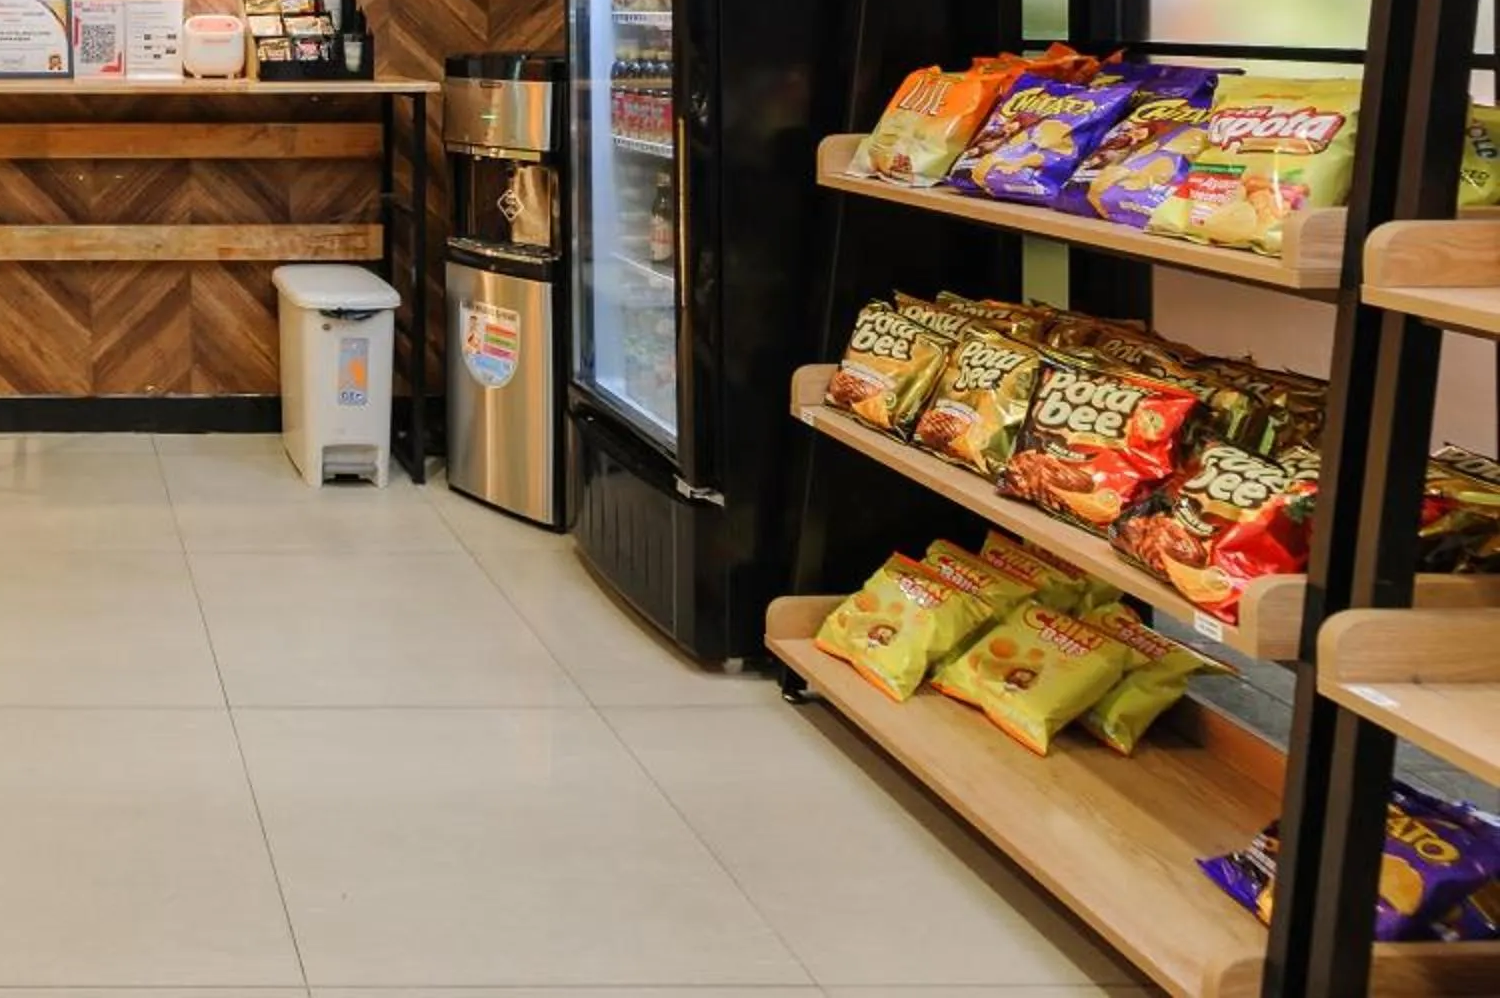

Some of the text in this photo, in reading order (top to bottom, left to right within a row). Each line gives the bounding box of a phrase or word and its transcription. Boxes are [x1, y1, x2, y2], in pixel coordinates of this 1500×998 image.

[851, 323, 912, 360] bee
[1038, 391, 1123, 437] bee
[1039, 370, 1143, 414] Pota
